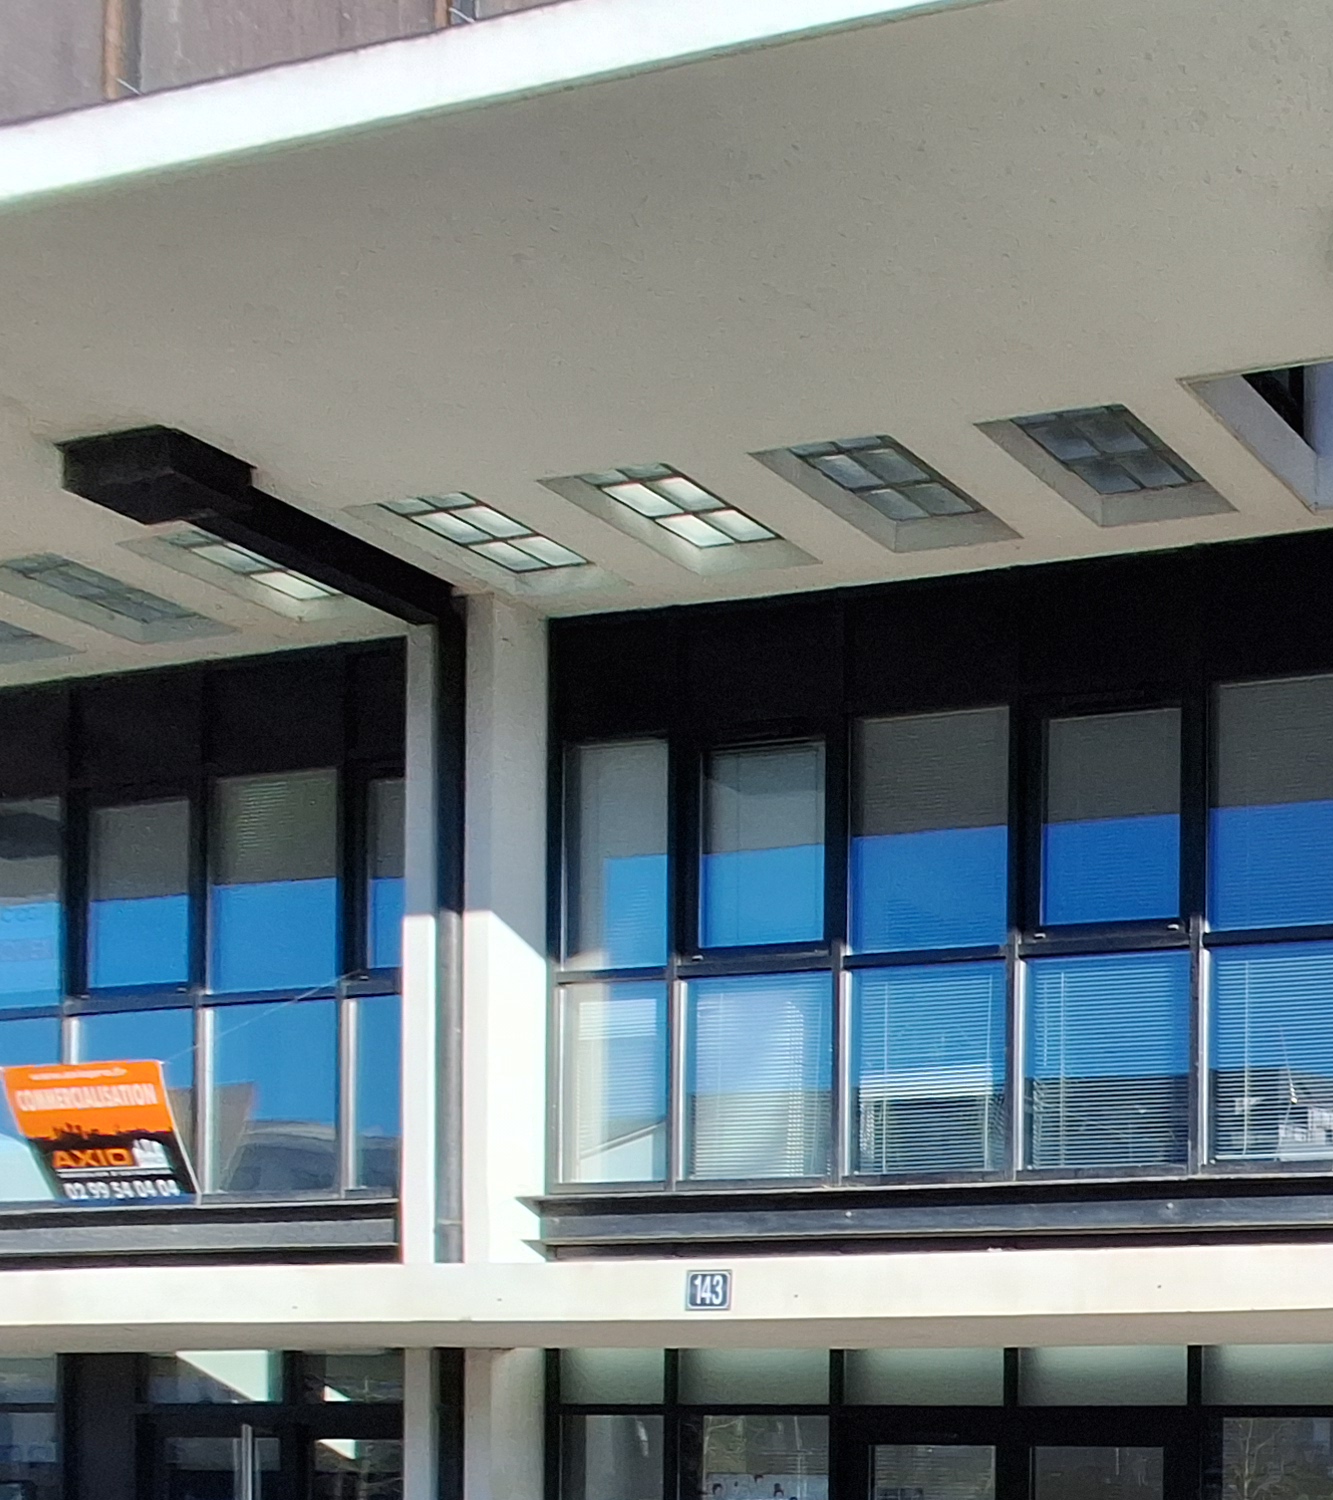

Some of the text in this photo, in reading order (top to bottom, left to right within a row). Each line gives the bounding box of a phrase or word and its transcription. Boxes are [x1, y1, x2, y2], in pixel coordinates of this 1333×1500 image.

[15, 1083, 158, 1111] COMMERCIALISATION
[53, 1148, 133, 1168] AXIO
[63, 1178, 180, 1199] 02 99 54 04 04
[694, 1275, 723, 1304] 143
